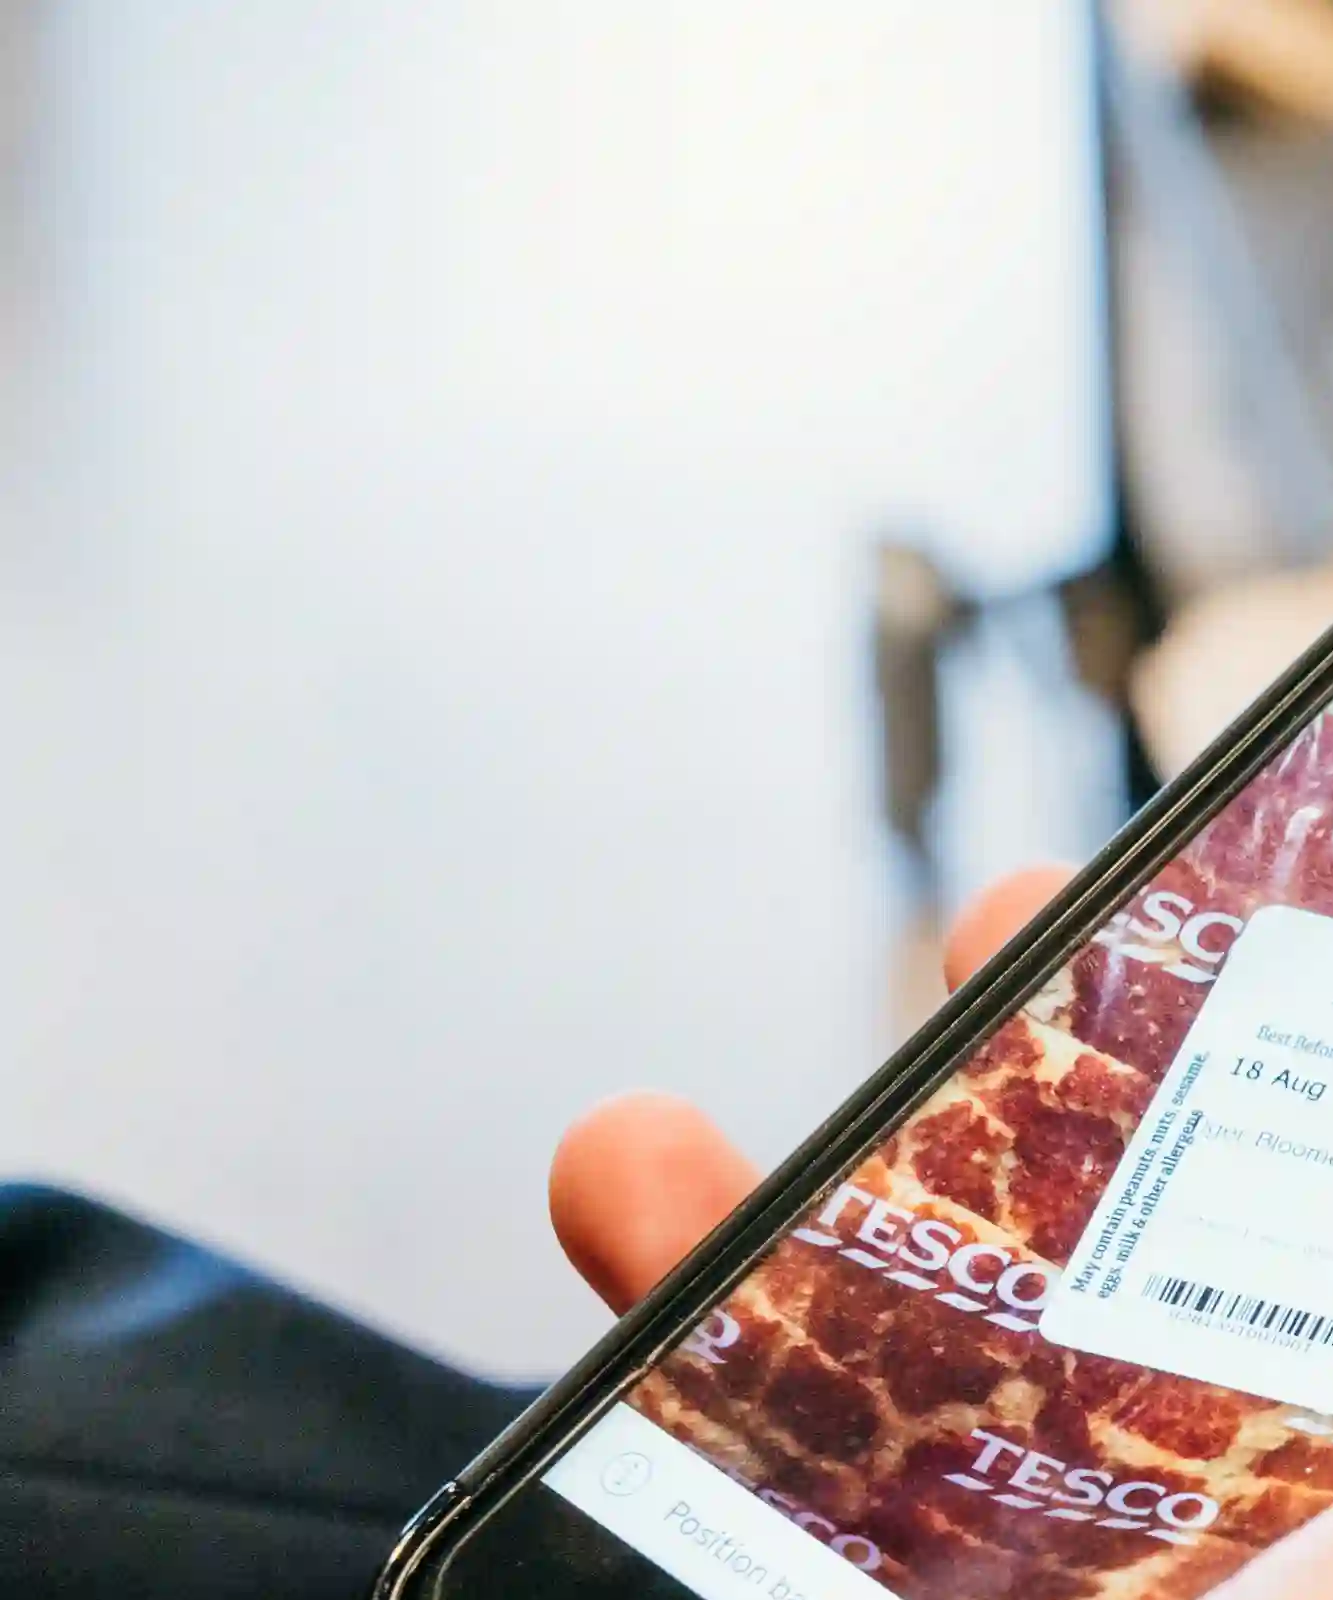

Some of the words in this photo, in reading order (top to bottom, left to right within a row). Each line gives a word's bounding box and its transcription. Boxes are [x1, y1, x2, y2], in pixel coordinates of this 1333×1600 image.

[1229, 1056, 1264, 1080] 18
[1270, 1068, 1328, 1101] Aug
[1256, 1023, 1293, 1046] Best
[1116, 1226, 1142, 1264] milk
[1132, 1211, 1148, 1230] &
[1140, 1177, 1169, 1217] other
[1160, 1109, 1205, 1177] allergens
[816, 1182, 1063, 1311] TESCO
[1070, 1257, 1102, 1294] May
[1091, 1203, 1128, 1260] contain
[968, 1427, 1221, 1533] TESCO
[663, 1499, 769, 1586] Position
